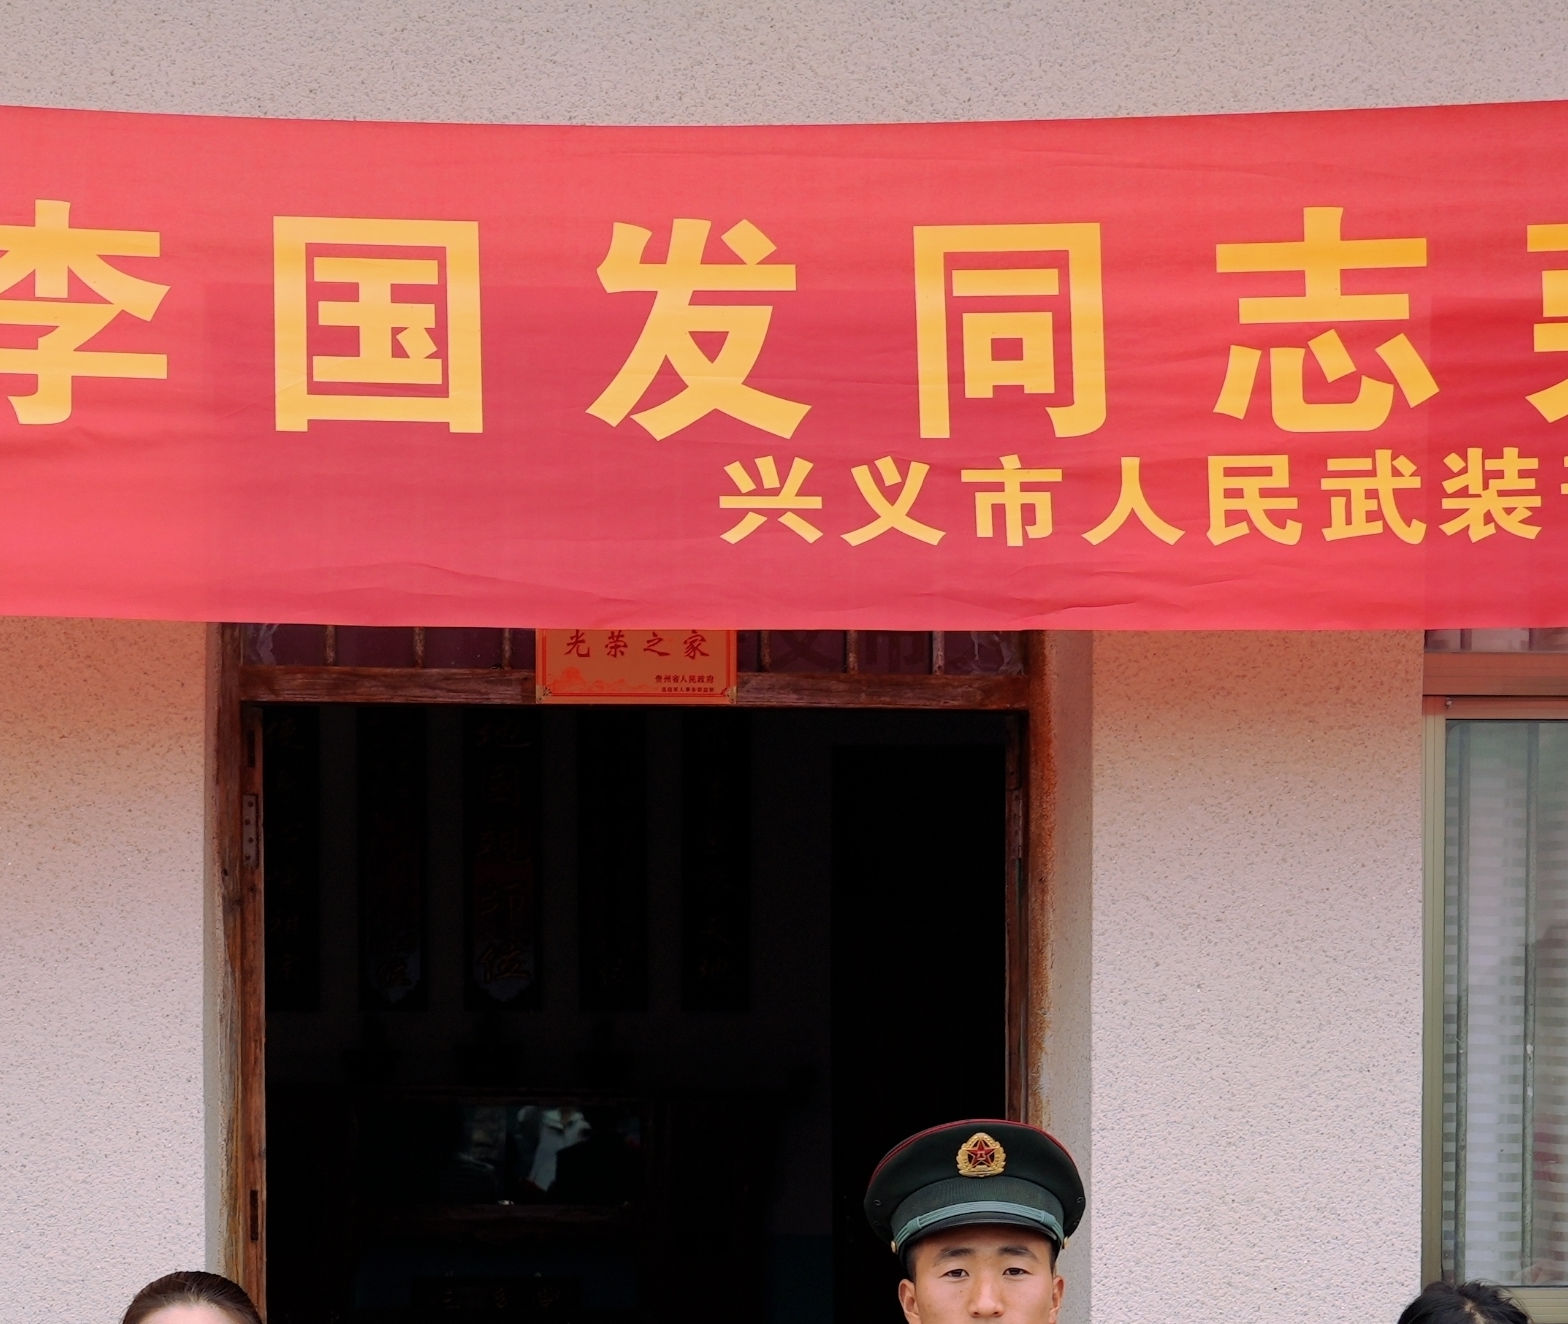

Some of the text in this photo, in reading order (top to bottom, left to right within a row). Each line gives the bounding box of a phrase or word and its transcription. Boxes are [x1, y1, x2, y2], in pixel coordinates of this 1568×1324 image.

[564, 629, 710, 660] 光荣之家
[655, 674, 714, 684] 贵州省人民政府
